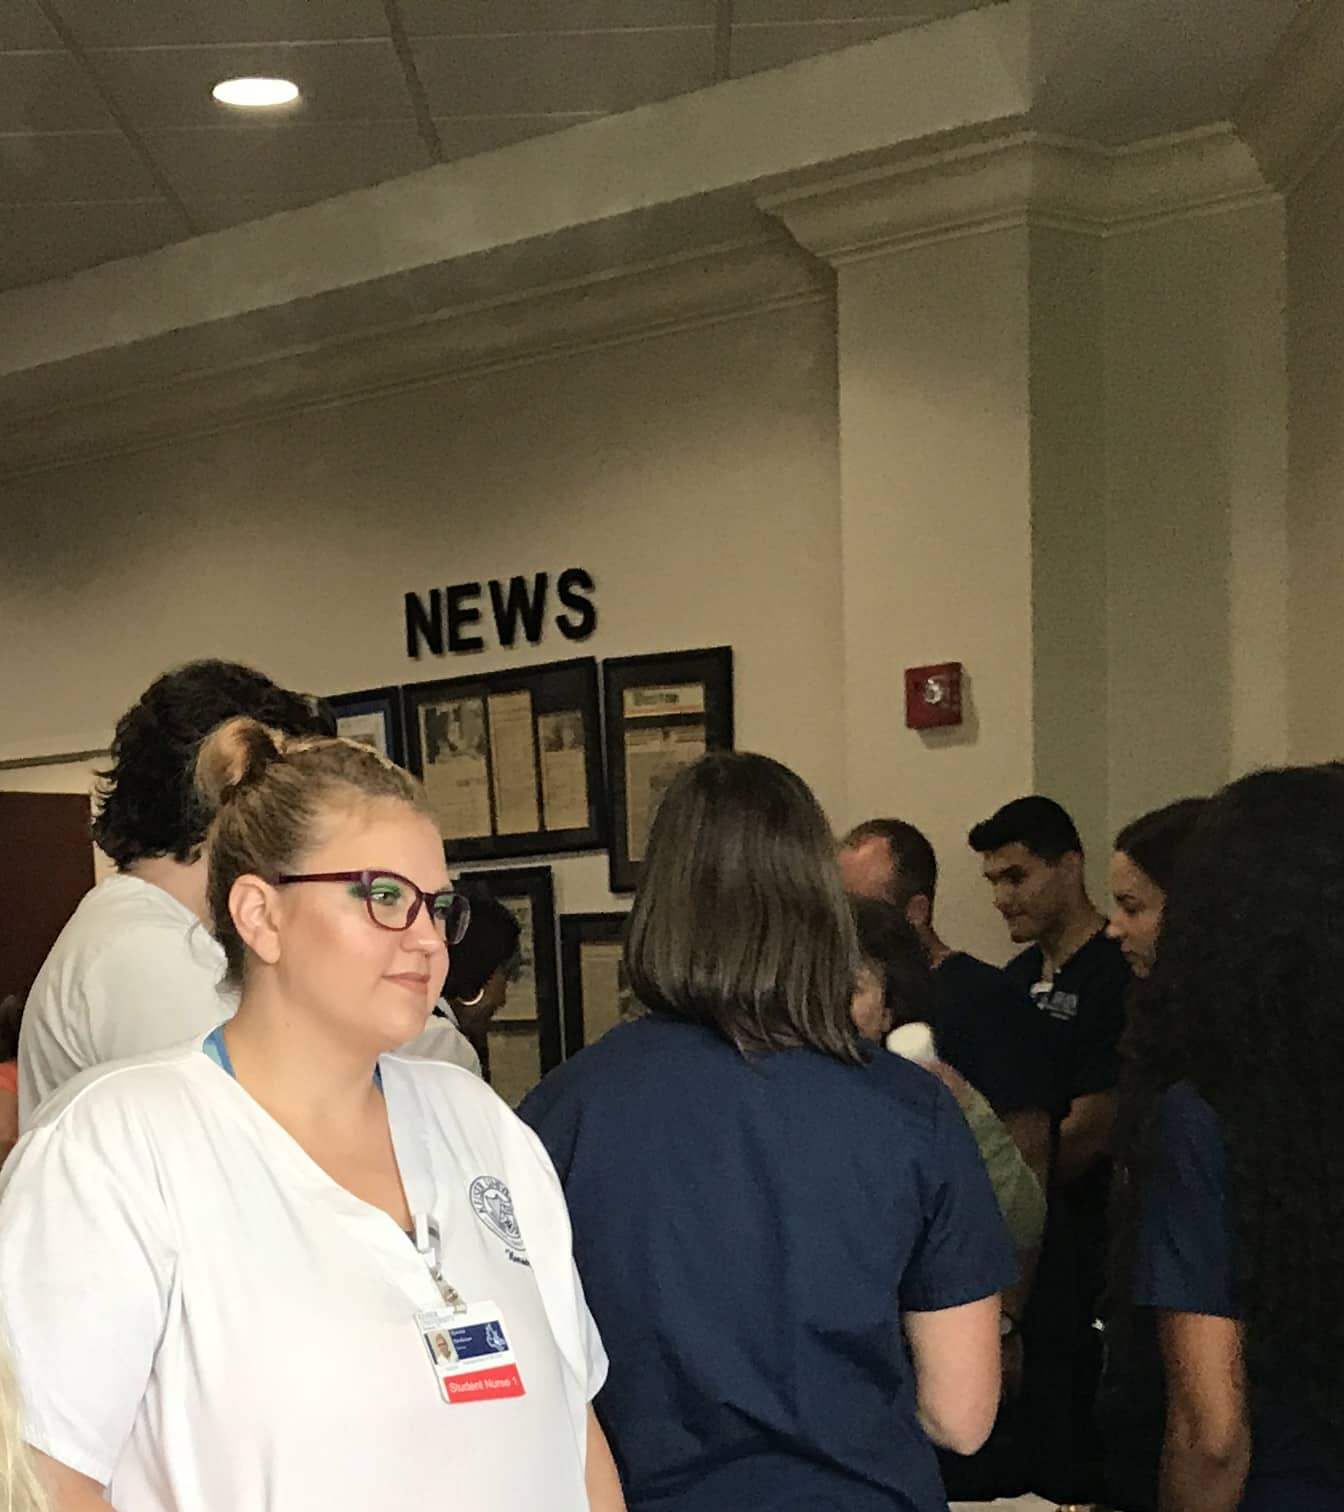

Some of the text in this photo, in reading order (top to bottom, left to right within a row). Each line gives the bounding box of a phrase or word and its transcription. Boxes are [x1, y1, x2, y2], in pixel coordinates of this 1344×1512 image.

[405, 568, 596, 659] NEWS
[449, 1379, 483, 1393] Student
[484, 1378, 511, 1390] Nurse
